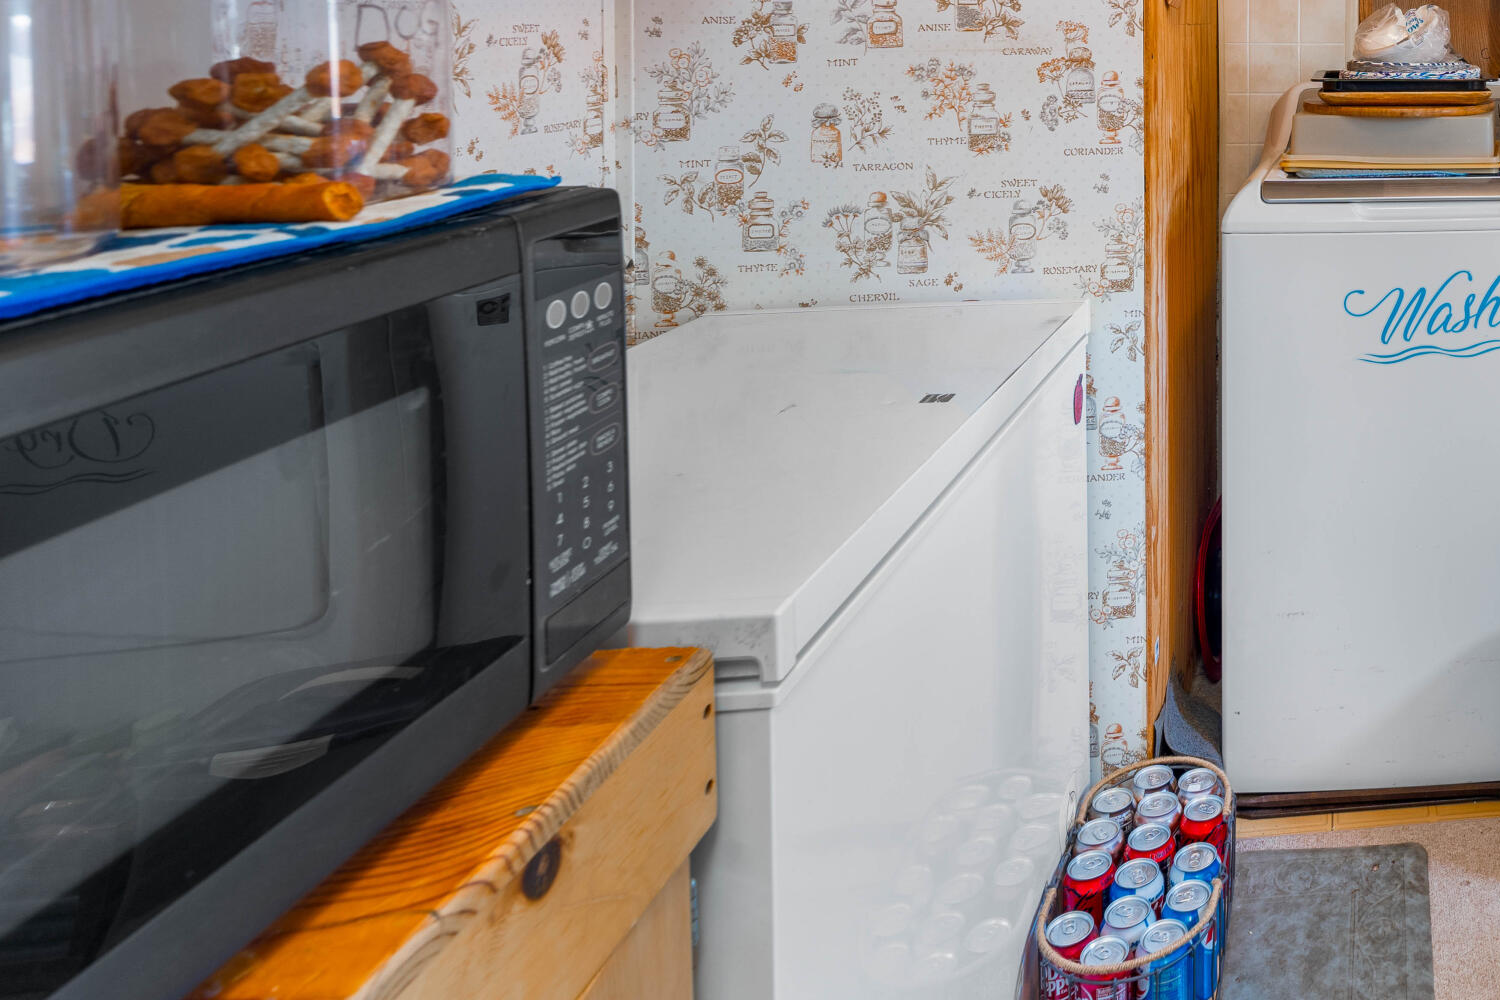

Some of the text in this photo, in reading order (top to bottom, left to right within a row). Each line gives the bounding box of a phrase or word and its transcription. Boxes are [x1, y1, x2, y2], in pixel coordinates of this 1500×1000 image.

[701, 15, 736, 25] ANISE
[512, 23, 540, 34] SWEET
[918, 23, 950, 33] ANISE
[499, 36, 528, 47] CICELY
[1001, 46, 1052, 56] CARAWAY
[826, 58, 859, 68] MINT
[543, 119, 582, 134] ROSEMARY
[927, 136, 967, 146] THYME
[1063, 146, 1123, 157] CORIANDER
[679, 159, 711, 169] MINT
[852, 161, 914, 172] TARRAGON
[1001, 178, 1038, 188] SWEET
[984, 190, 1021, 200] CICELY
[738, 263, 778, 273] THYME
[1043, 264, 1098, 275] ROSEMARY
[908, 278, 939, 288] SAGE
[849, 292, 900, 302] CHERVIL
